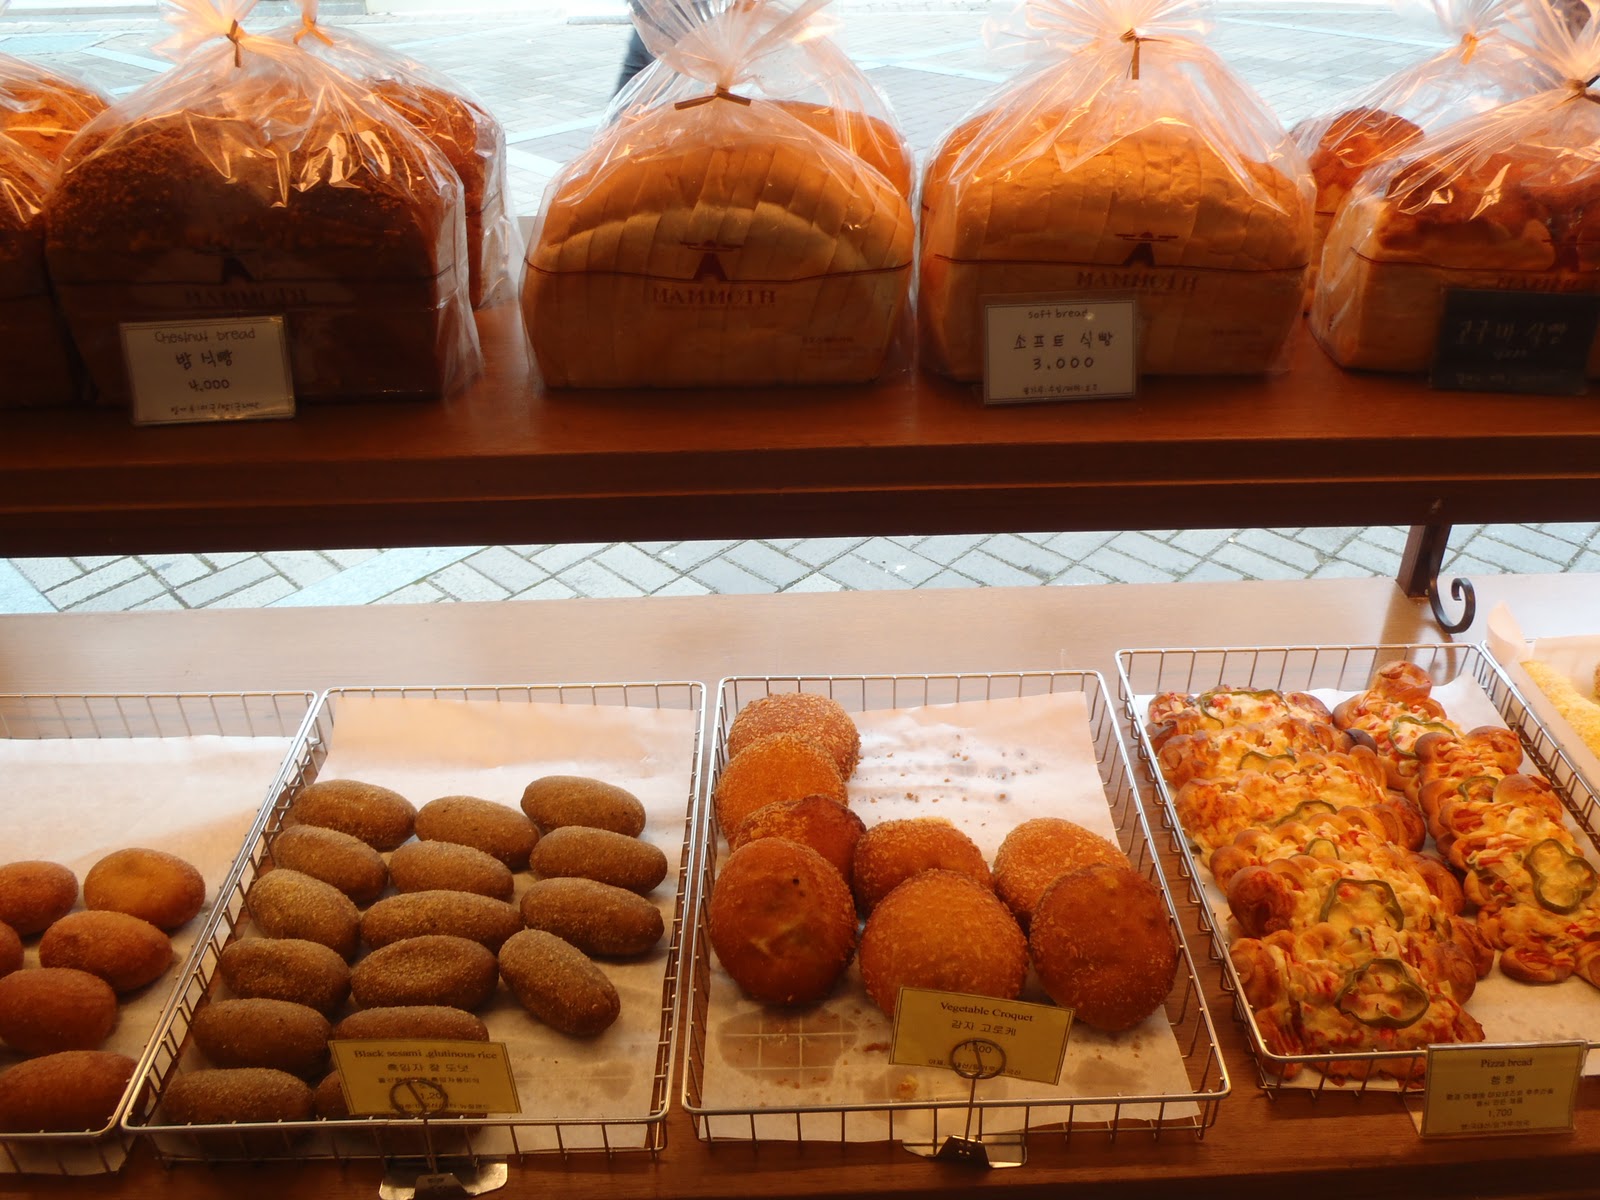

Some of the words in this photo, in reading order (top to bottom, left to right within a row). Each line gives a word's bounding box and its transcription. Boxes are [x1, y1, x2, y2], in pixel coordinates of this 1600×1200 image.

[652, 287, 777, 305] MAMMOTH
[1028, 309, 1052, 319] soft
[216, 328, 256, 341] bread
[941, 1002, 990, 1016] Vegetable
[992, 1009, 1034, 1022] Croquet
[951, 1019, 975, 1031] 감자
[979, 1023, 1017, 1037] 고로케
[354, 1050, 384, 1059] Black
[477, 1052, 497, 1060] rice
[1481, 1059, 1506, 1069] Pizza
[1507, 1058, 1533, 1067] bread
[1488, 1108, 1513, 1119] 1,700
